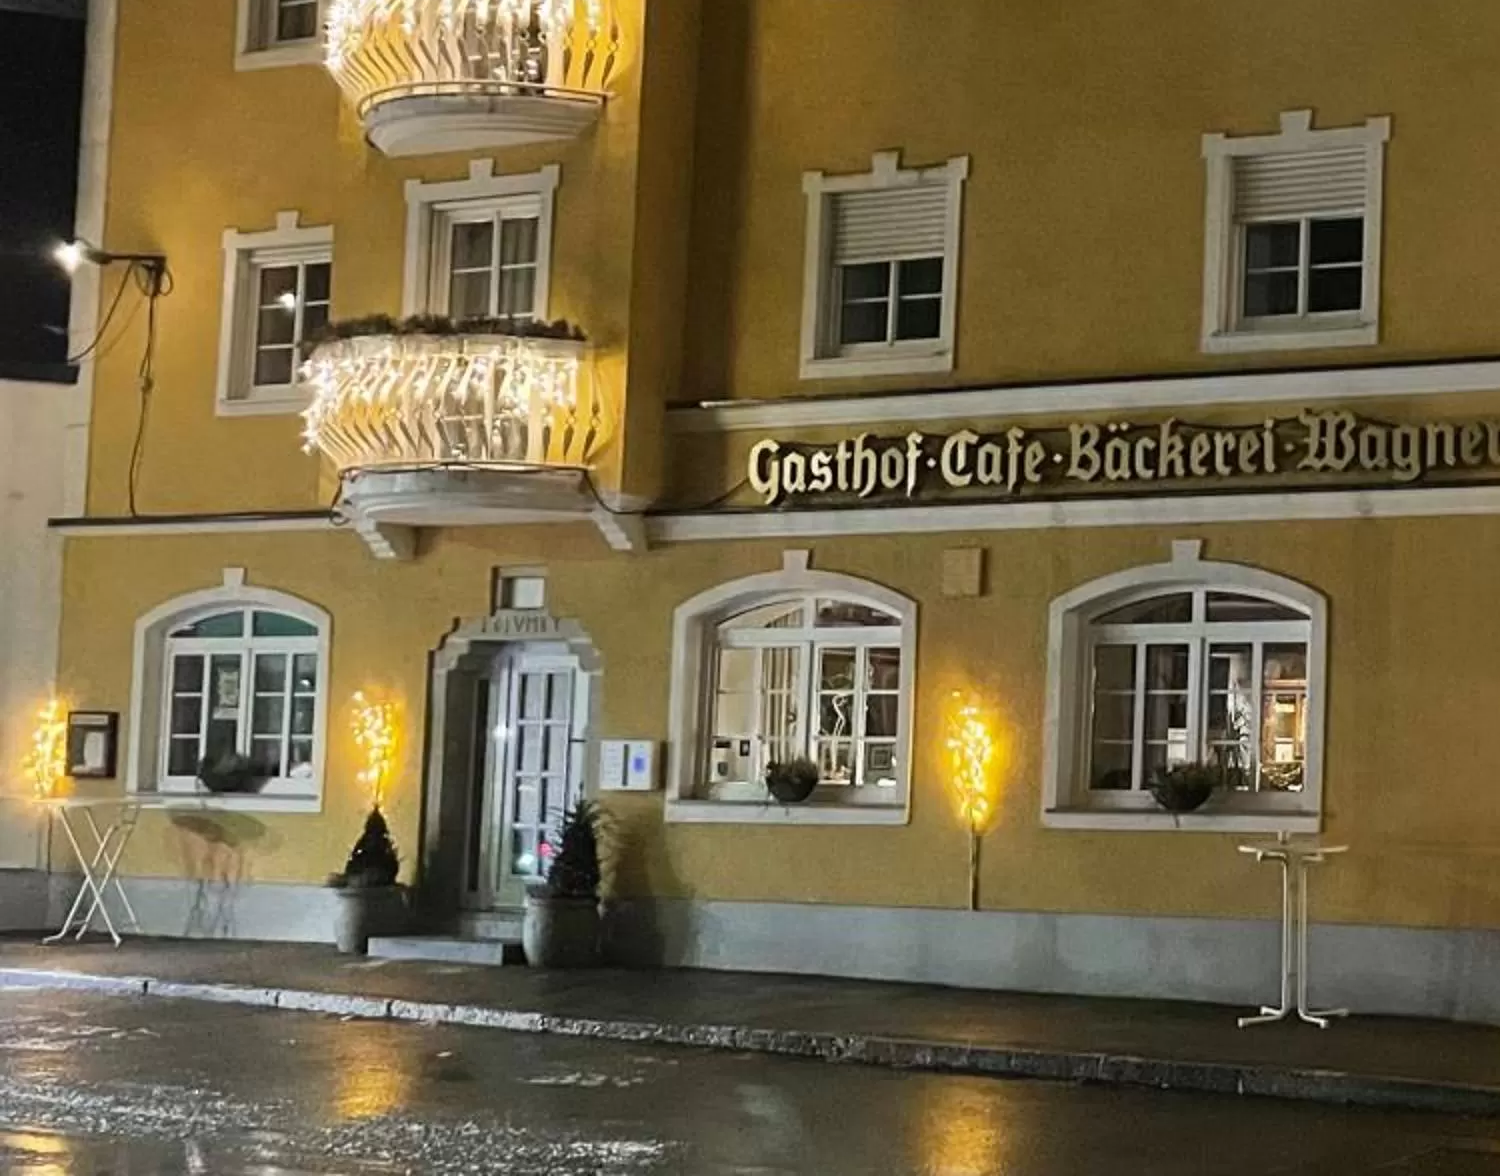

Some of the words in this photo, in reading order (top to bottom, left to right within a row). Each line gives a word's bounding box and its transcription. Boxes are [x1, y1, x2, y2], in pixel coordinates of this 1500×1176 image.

[748, 431, 923, 505] Gasthof
[941, 426, 1045, 492] Cafe
[1067, 417, 1276, 481] Bäckerei
